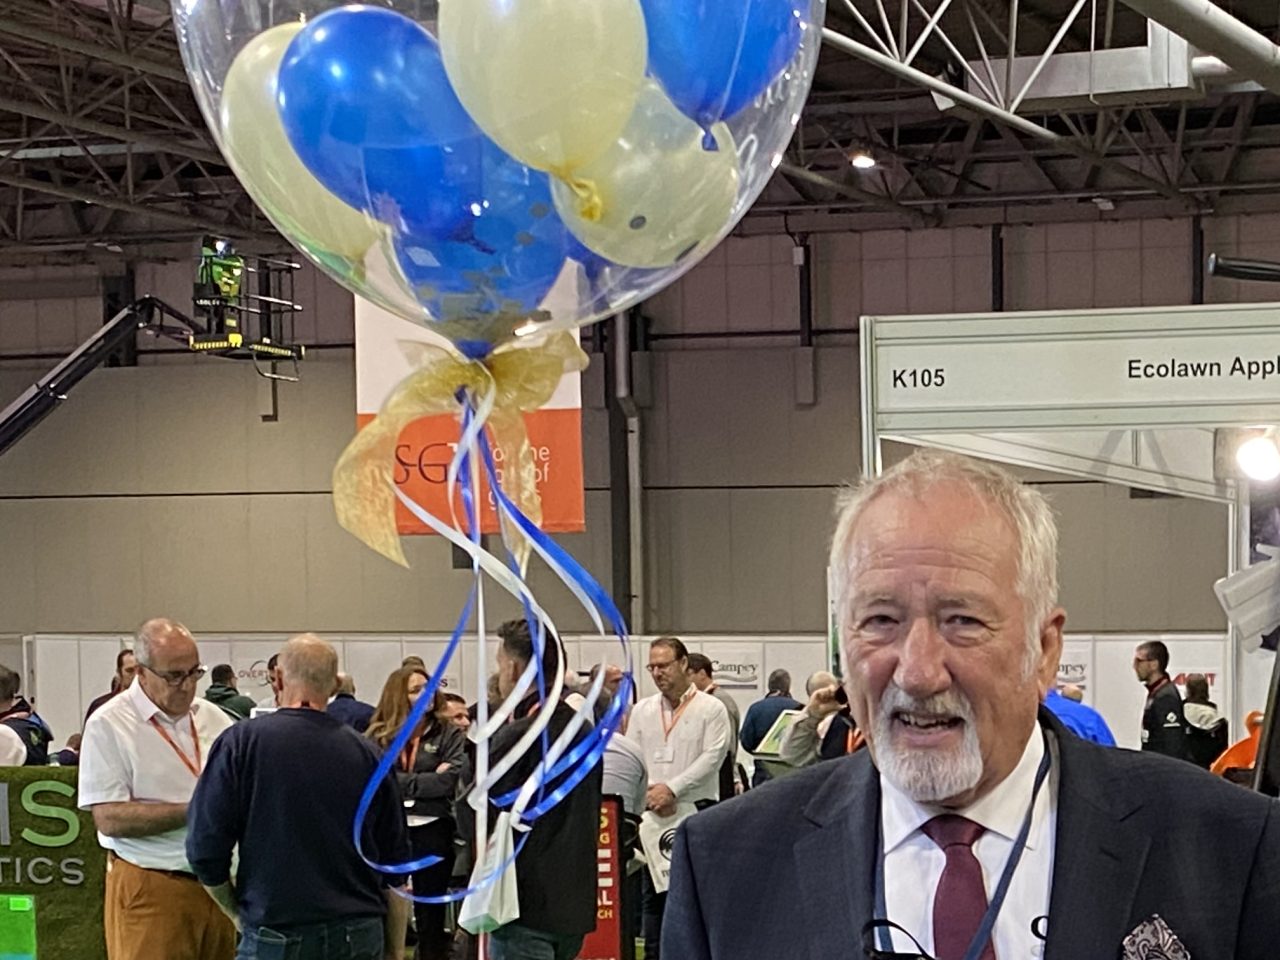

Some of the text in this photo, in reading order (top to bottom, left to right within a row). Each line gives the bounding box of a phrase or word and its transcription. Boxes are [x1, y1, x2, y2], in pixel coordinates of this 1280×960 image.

[1128, 358, 1221, 379] Ecolawn
[892, 368, 946, 388] K105
[711, 660, 758, 674] Campey
[1059, 663, 1087, 674] mpey
